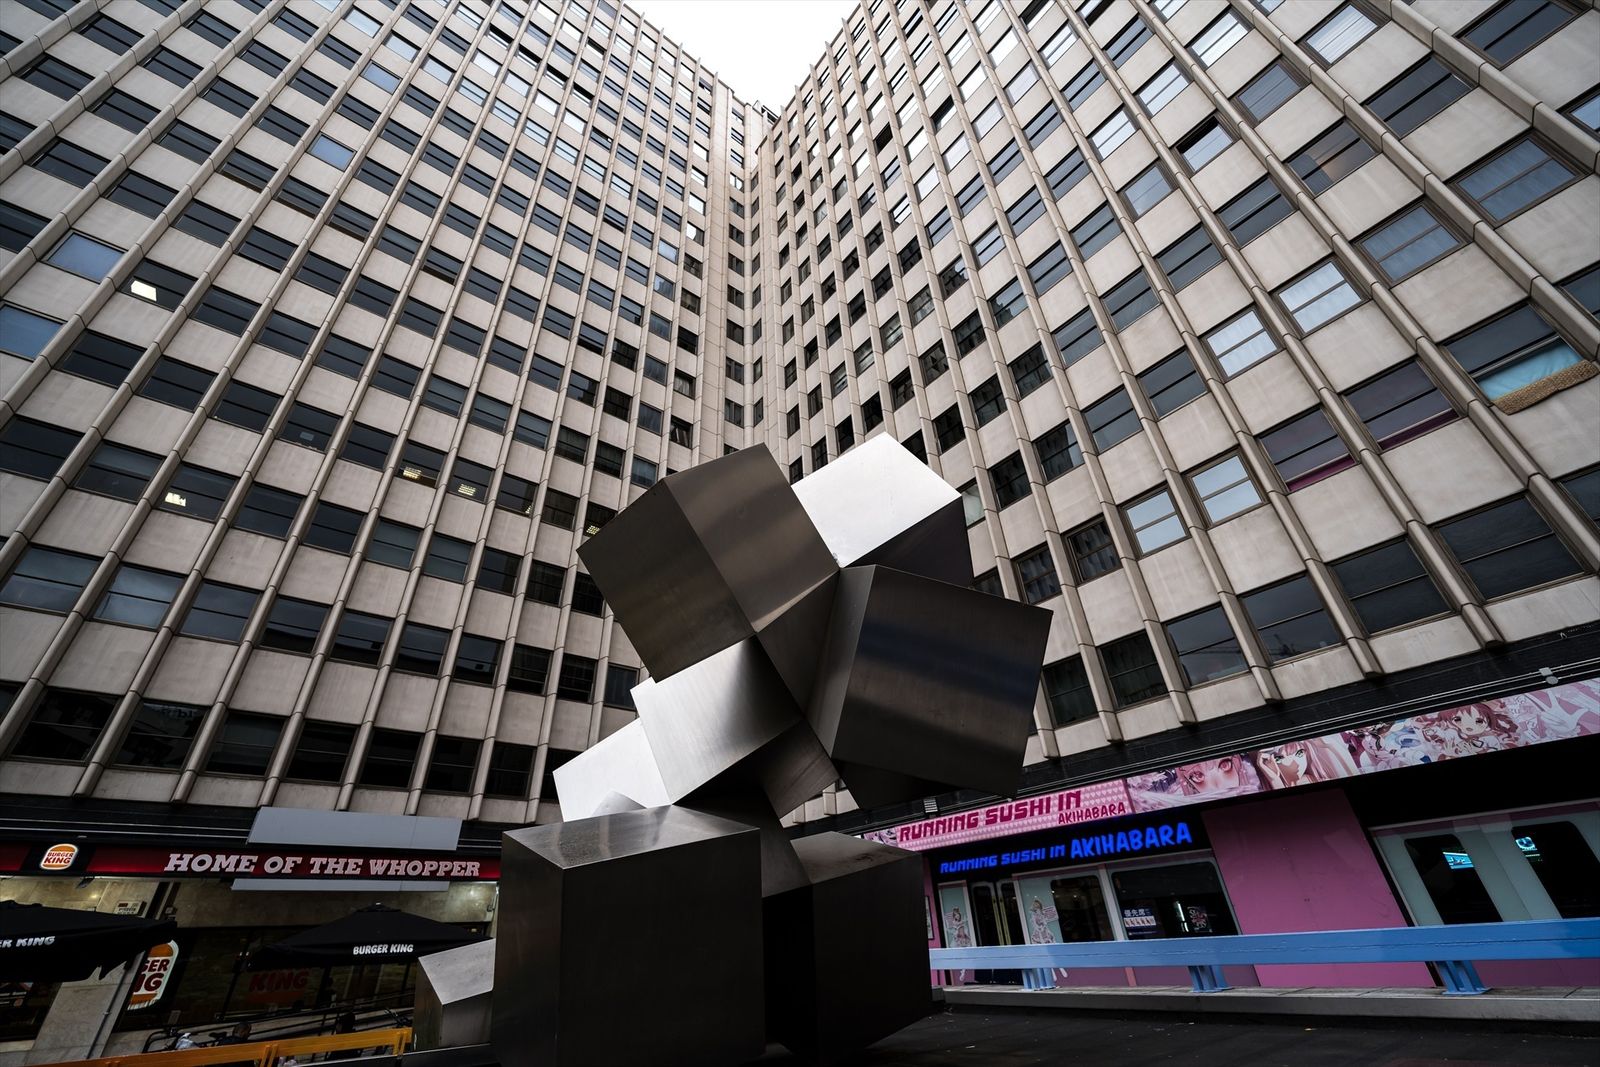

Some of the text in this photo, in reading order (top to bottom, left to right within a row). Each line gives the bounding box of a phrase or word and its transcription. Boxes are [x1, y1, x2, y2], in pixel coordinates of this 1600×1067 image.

[900, 790, 1081, 842] RUNNING SUSHI IN
[1058, 802, 1126, 824] AKIHABARA
[940, 823, 1192, 874] RUNNING SUSHI IN AKIHABARA
[164, 853, 481, 877] HOME OF THE WHOPPER
[16, 936, 56, 947] KING
[353, 943, 414, 955] BURGER KING
